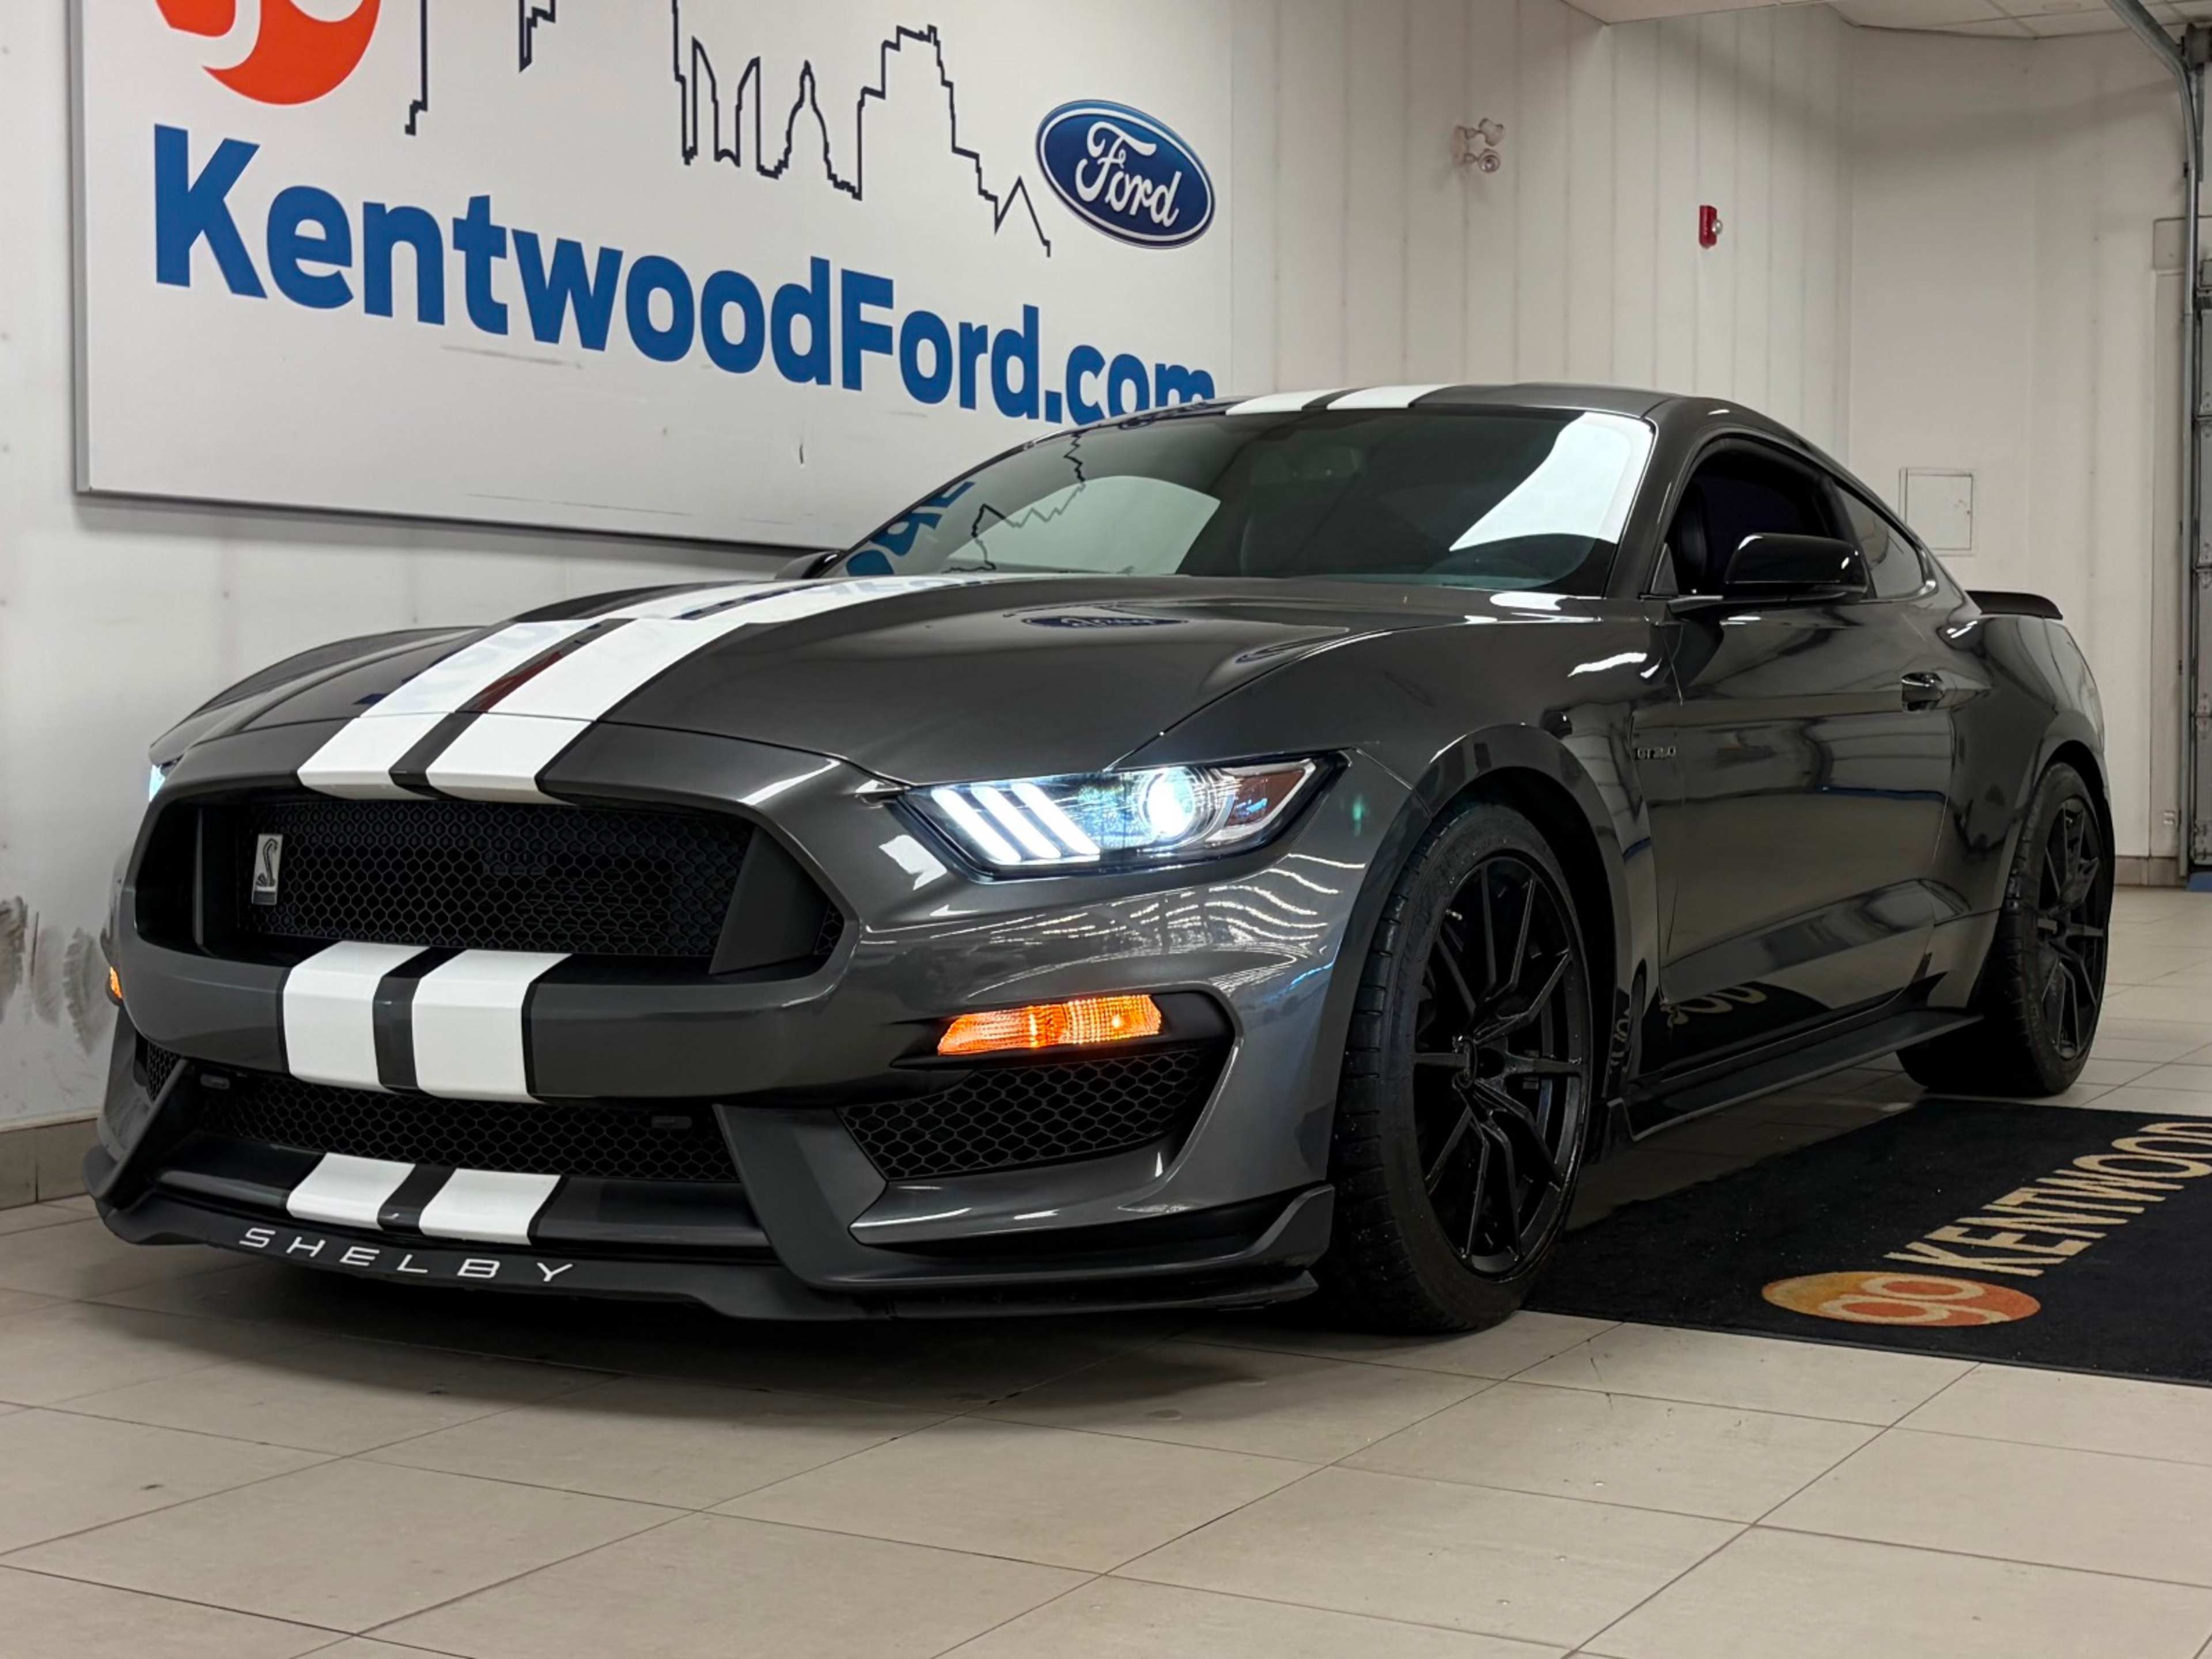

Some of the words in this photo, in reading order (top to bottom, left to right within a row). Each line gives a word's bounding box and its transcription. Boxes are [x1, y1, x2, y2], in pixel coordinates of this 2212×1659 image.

[1075, 121, 1182, 228] Ford
[154, 123, 1215, 425] KentwoodFord.com
[239, 1228, 573, 1282] SHELBY
